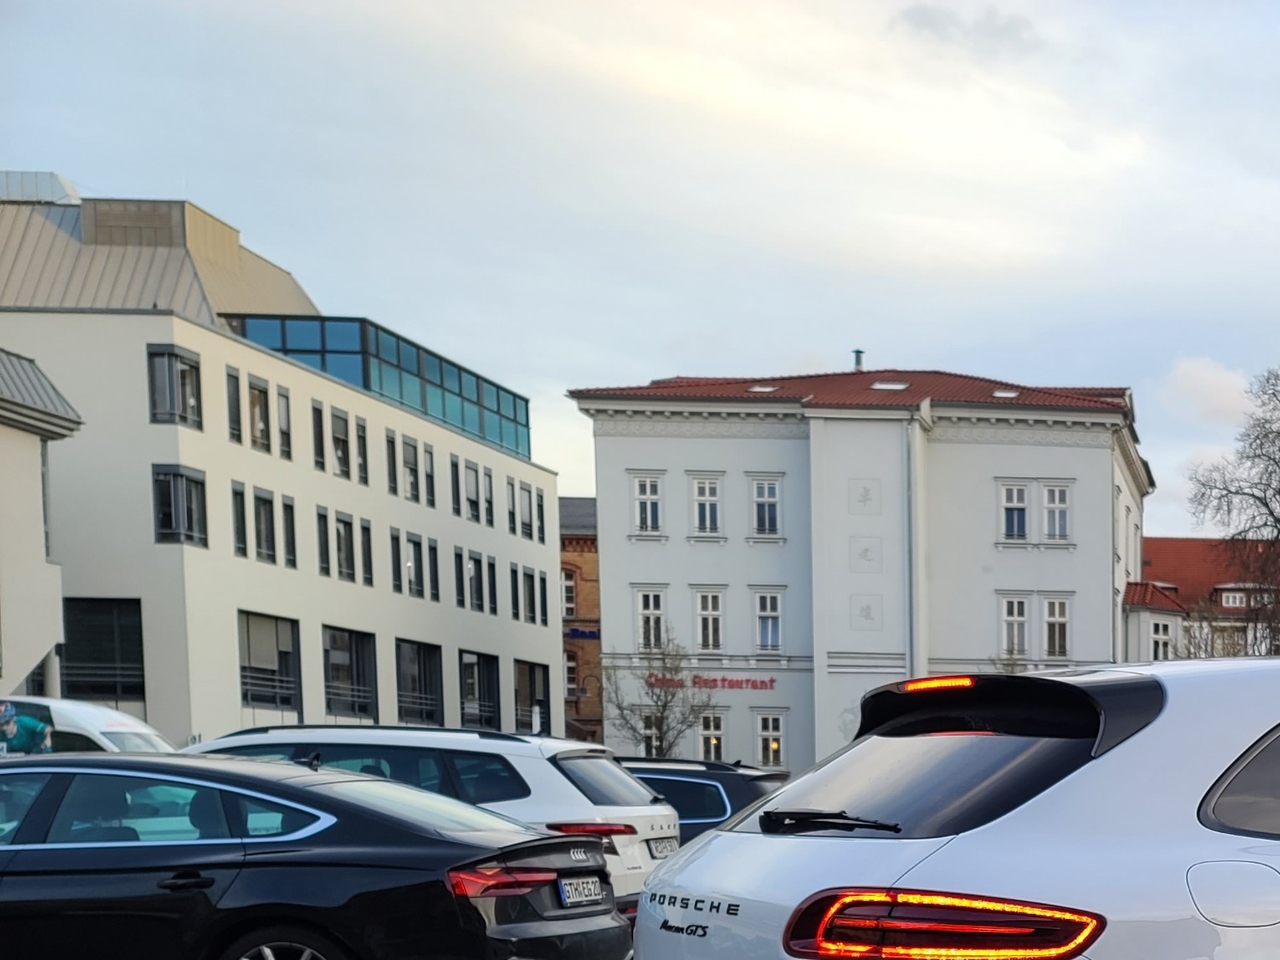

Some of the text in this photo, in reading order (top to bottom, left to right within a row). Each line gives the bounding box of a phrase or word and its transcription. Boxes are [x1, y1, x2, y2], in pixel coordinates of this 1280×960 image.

[691, 674, 777, 690] Restaurant
[649, 892, 741, 916] PORSCHE
[685, 924, 709, 938] GTS
